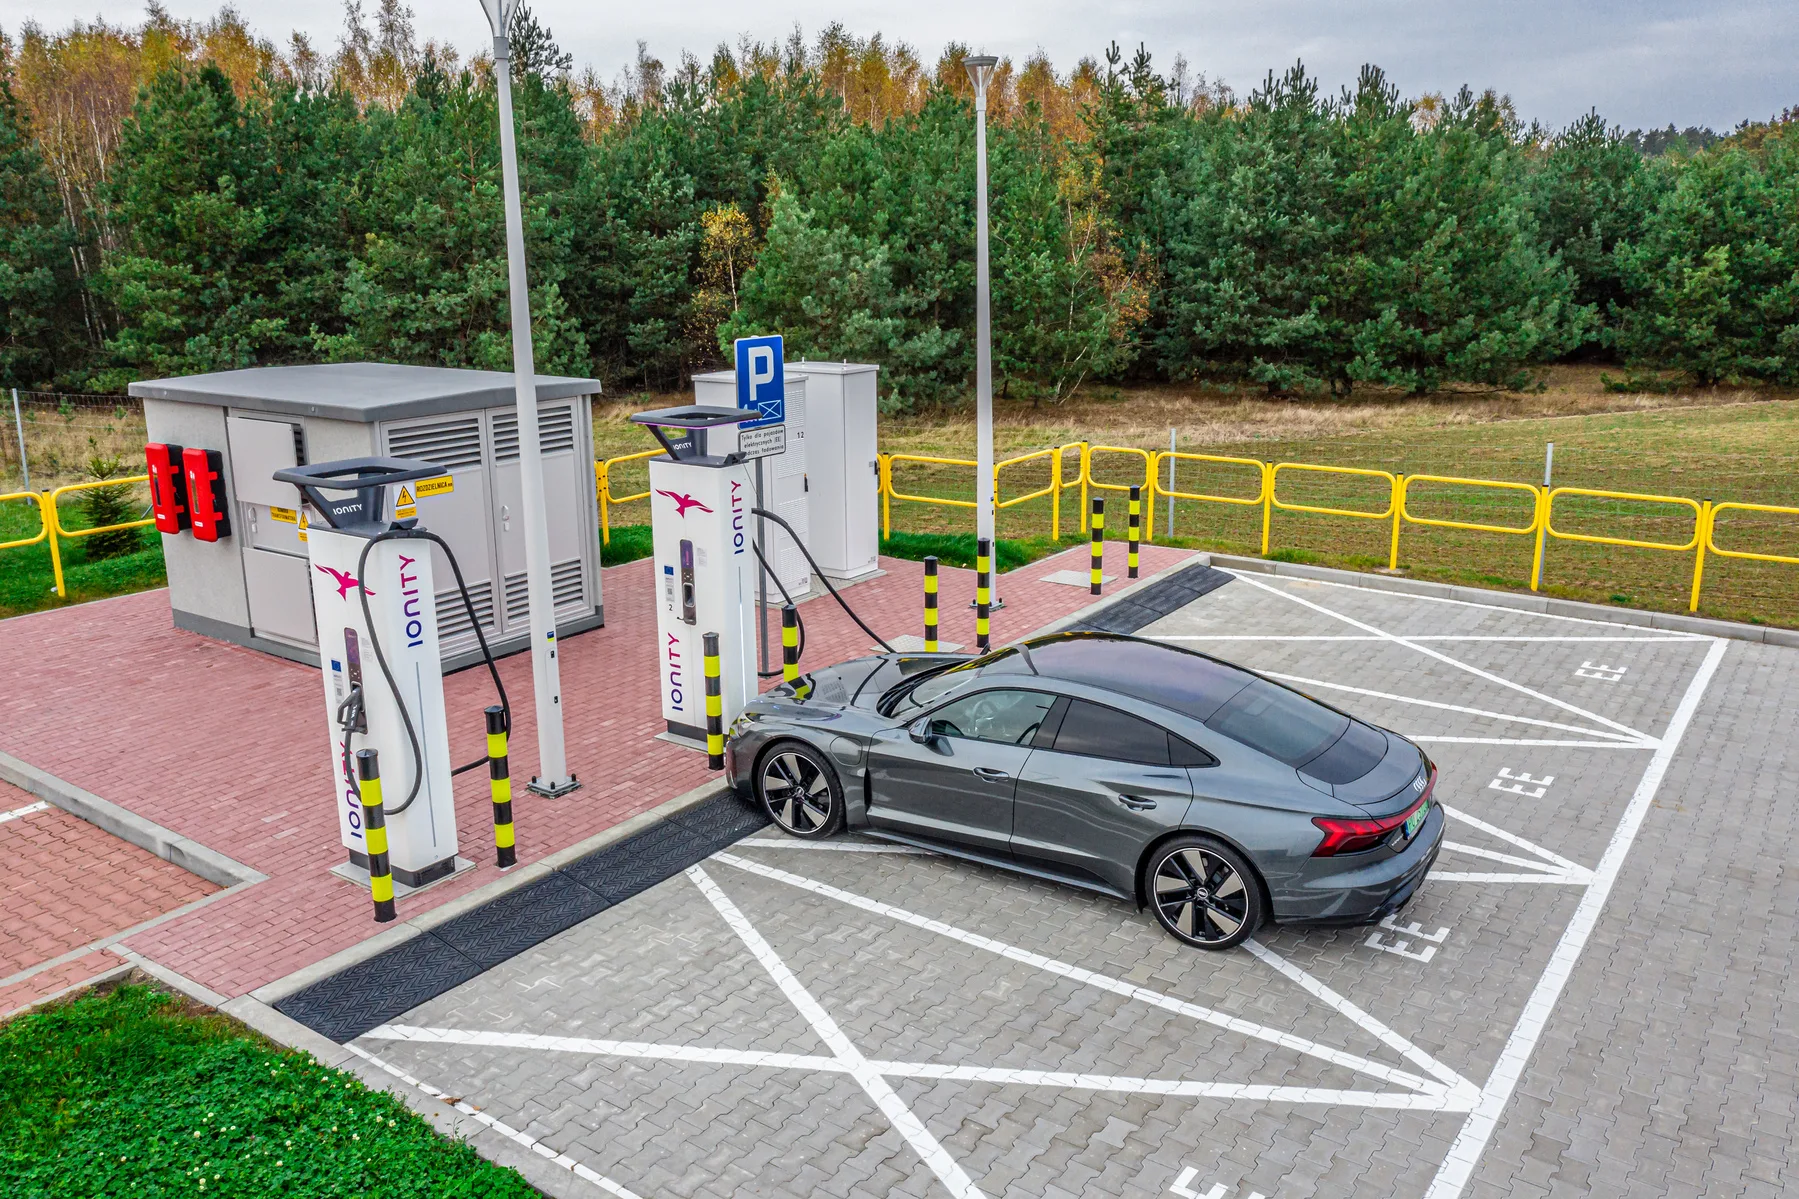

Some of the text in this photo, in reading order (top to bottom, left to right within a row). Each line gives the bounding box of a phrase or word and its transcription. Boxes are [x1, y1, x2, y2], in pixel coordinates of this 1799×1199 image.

[748, 346, 774, 401] P
[673, 442, 692, 450] IONITY
[332, 504, 362, 515] IONITY
[731, 480, 744, 554] IONITY
[399, 554, 423, 647] IONITY
[669, 603, 673, 611] 2
[668, 632, 683, 711] IONITY
[1488, 767, 1555, 799] EE
